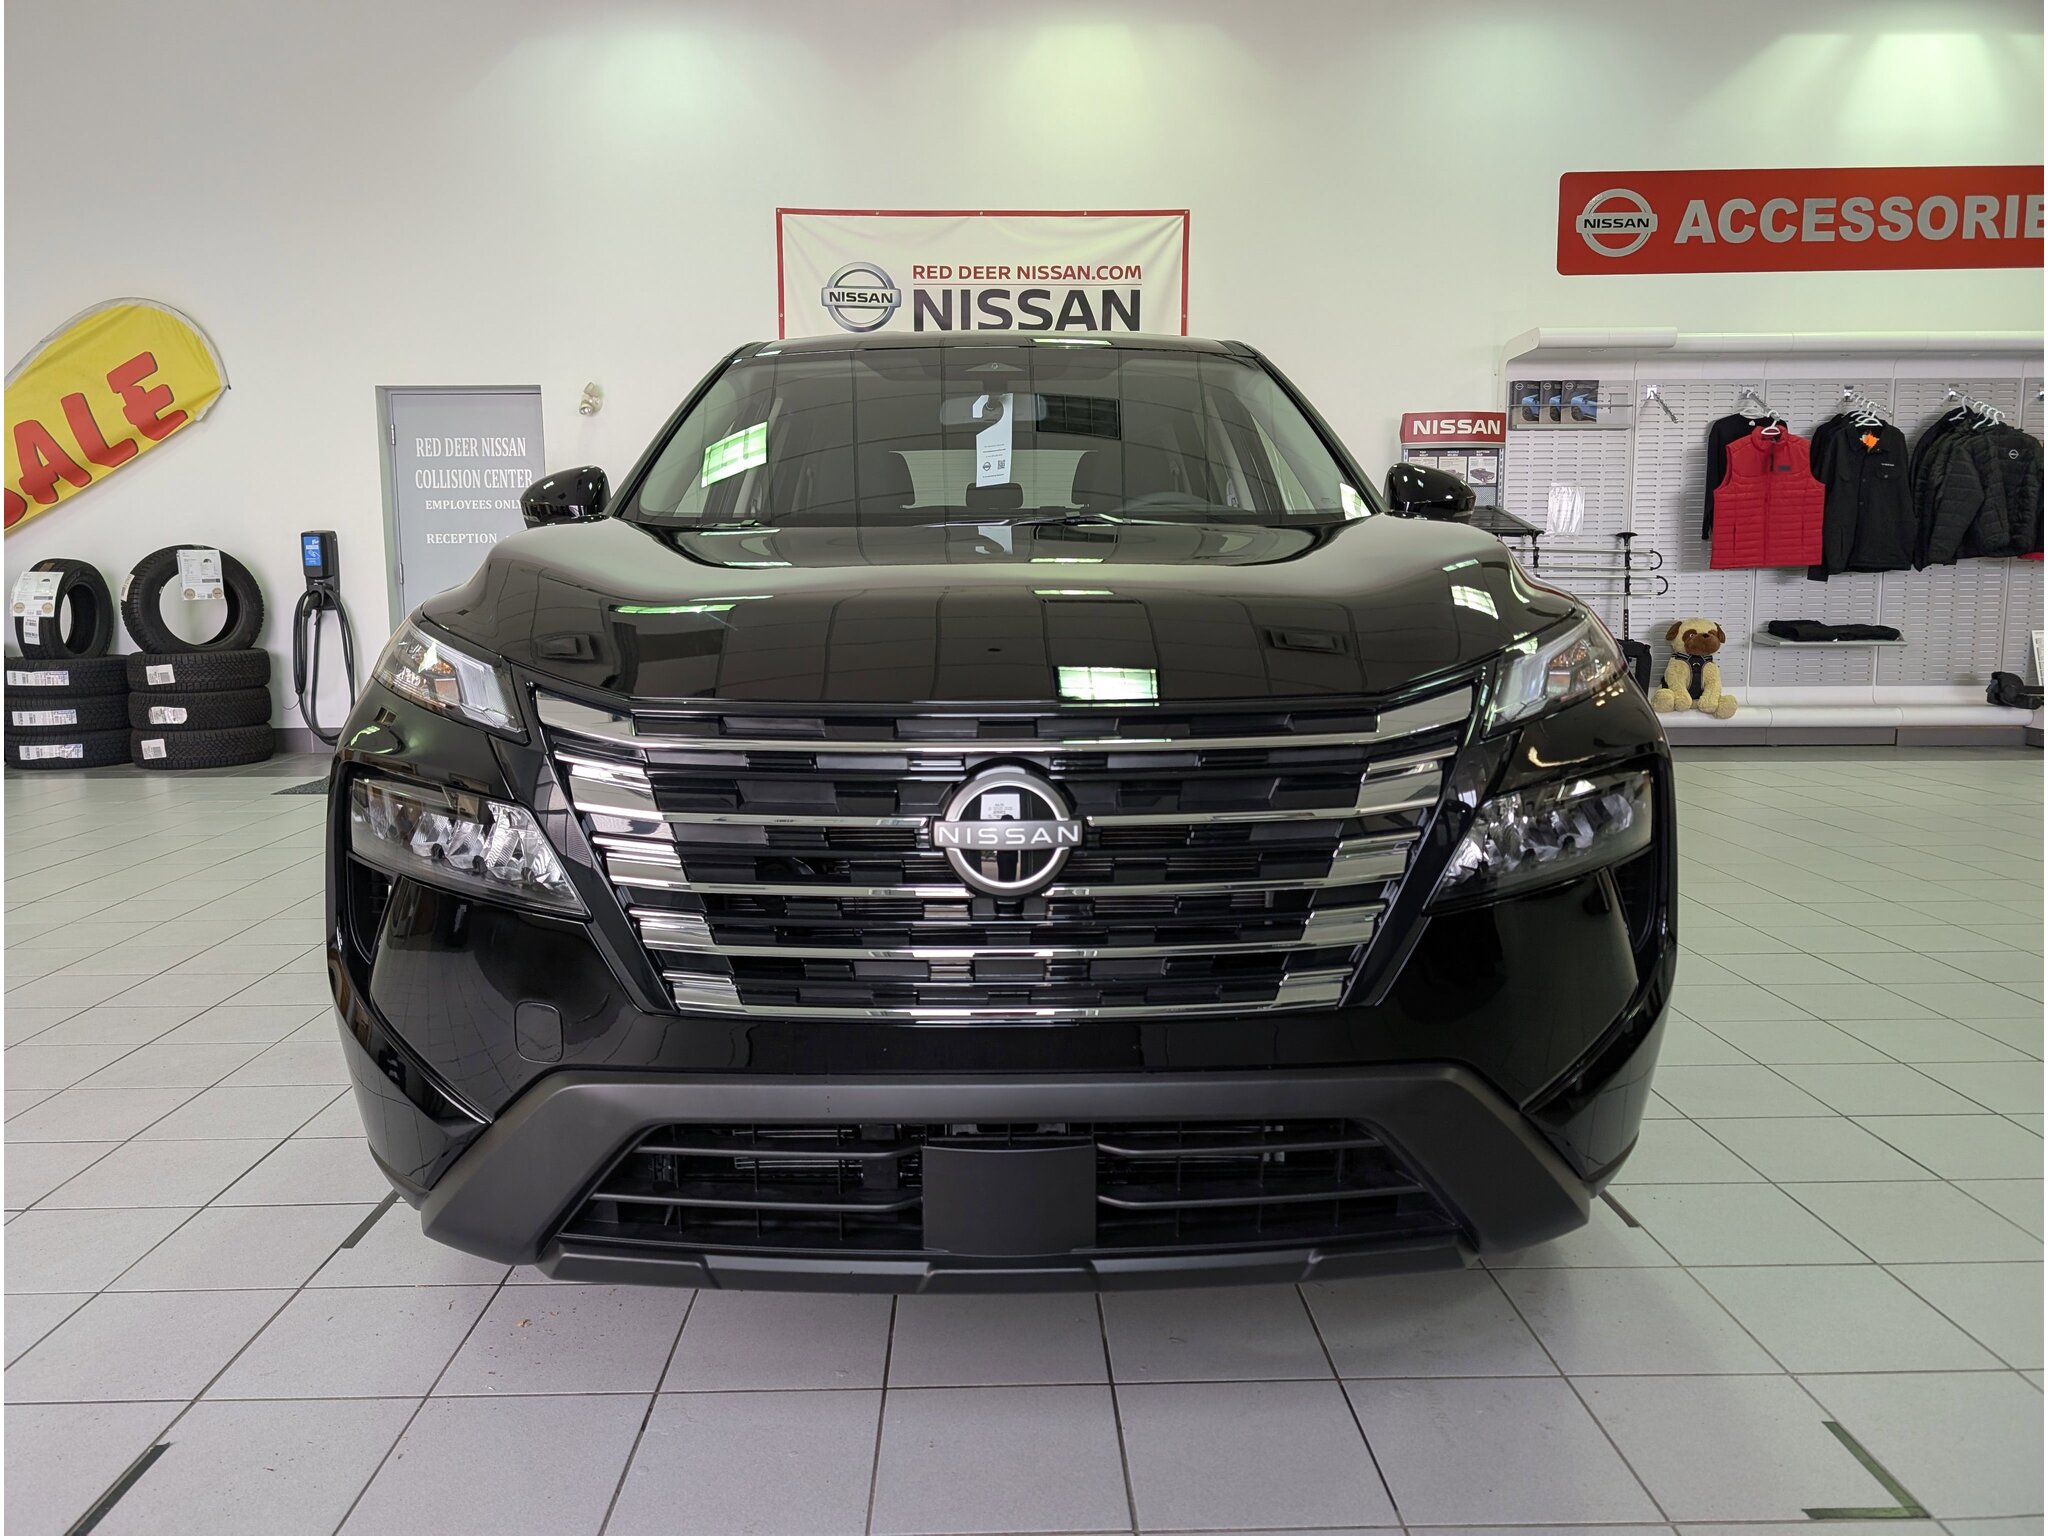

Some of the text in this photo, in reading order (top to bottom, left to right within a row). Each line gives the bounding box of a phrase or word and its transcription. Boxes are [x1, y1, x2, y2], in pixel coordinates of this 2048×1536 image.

[1583, 218, 1650, 229] NISSAN
[912, 264, 1142, 281] RED DEER NISSAN.COM
[828, 291, 894, 304] NISSAN
[912, 288, 1141, 332] NISSAN
[1413, 419, 1501, 435] NISSAN
[415, 437, 526, 457] RED DEER NISSAN
[415, 469, 533, 489] COLLISION CENTER
[425, 500, 492, 510] EMPLOYEES
[426, 533, 497, 544] RECEPTION
[938, 825, 1079, 845] NISSAN
